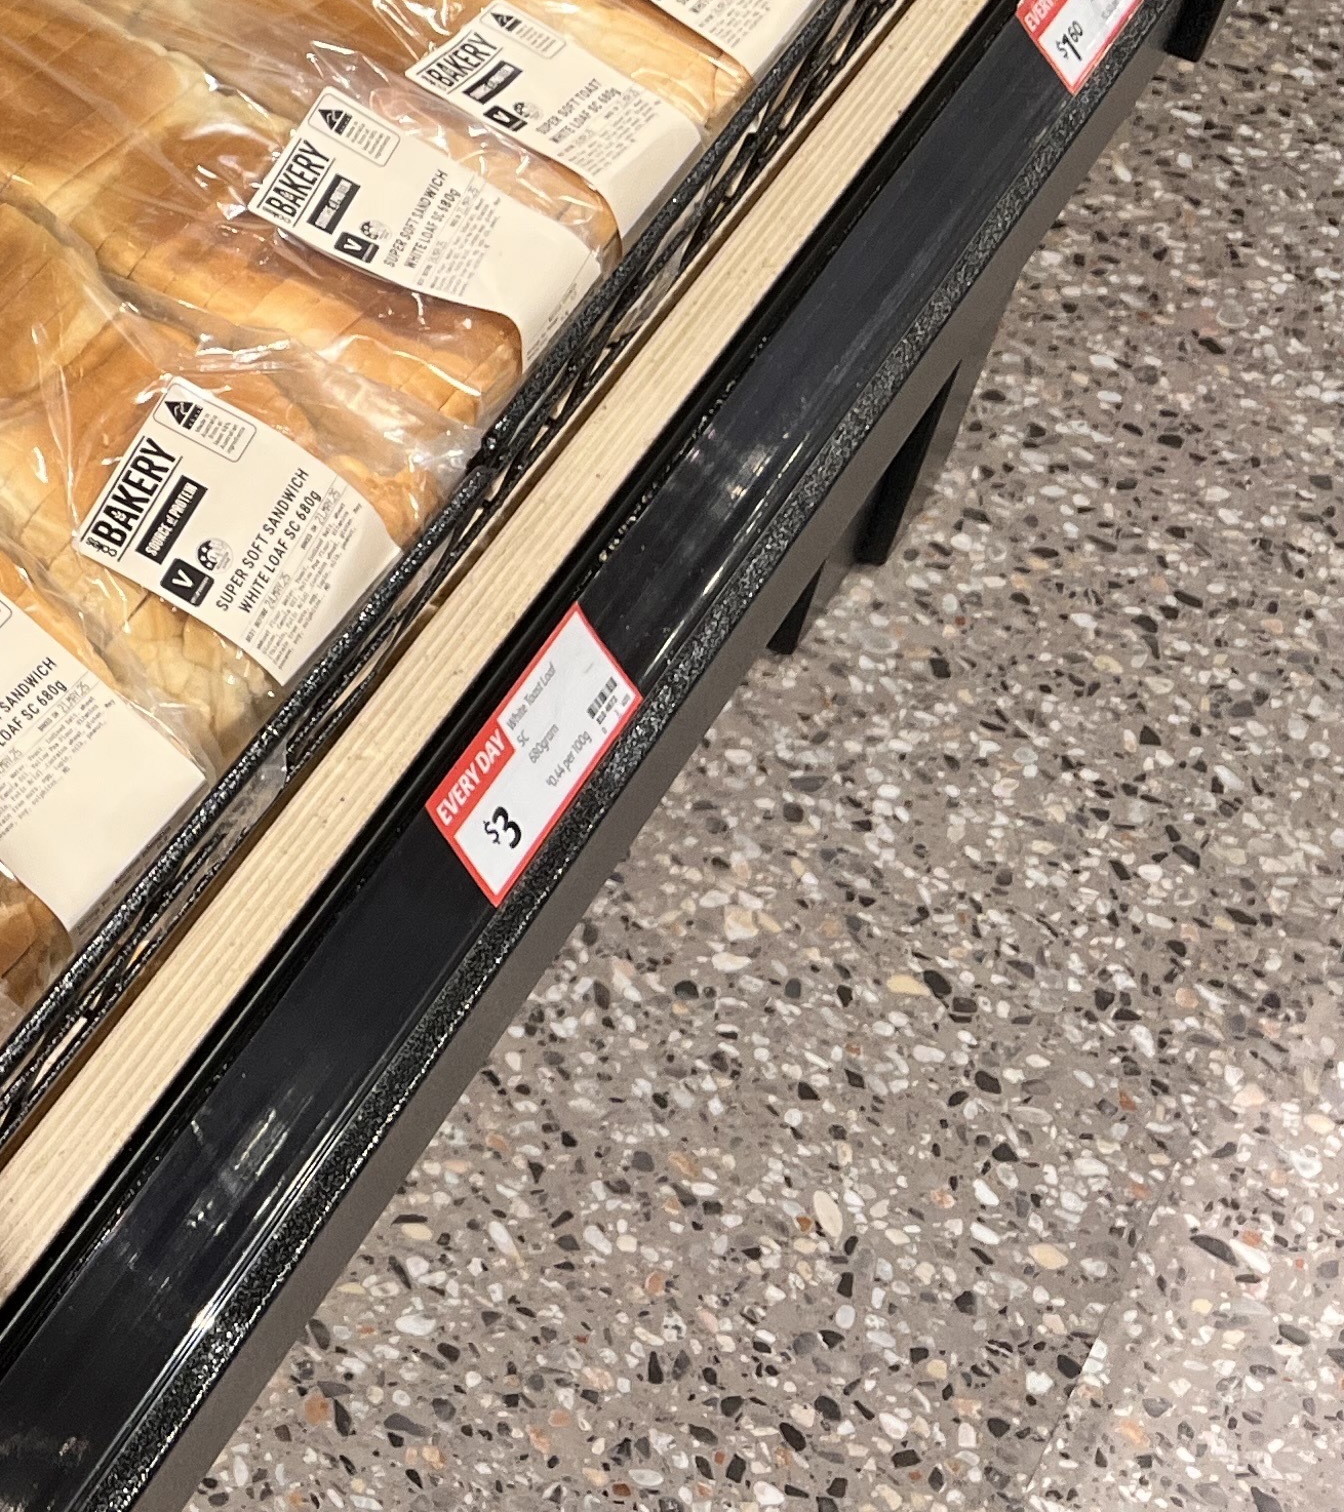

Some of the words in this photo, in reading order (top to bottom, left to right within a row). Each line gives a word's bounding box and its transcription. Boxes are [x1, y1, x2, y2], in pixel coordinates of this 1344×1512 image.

[432, 32, 498, 89] BAKERY
[267, 140, 330, 218] BAKERY
[91, 438, 175, 548] BAKERY
[215, 567, 246, 612] SUPER
[242, 534, 270, 571] SOFT
[263, 468, 309, 538] SANDWICH
[240, 570, 271, 614] WHITE
[267, 538, 292, 576] LOAF
[285, 518, 301, 541] SC
[298, 490, 322, 523] 680g
[0, 657, 58, 714] SANDWICH
[22, 702, 41, 722] SC
[38, 679, 68, 708] 680g
[518, 730, 530, 748] SC
[529, 723, 559, 764] 680gram
[572, 730, 592, 759] 100g
[436, 764, 483, 827] EVERY
[478, 728, 507, 776] DAY
[483, 806, 522, 849] $3
